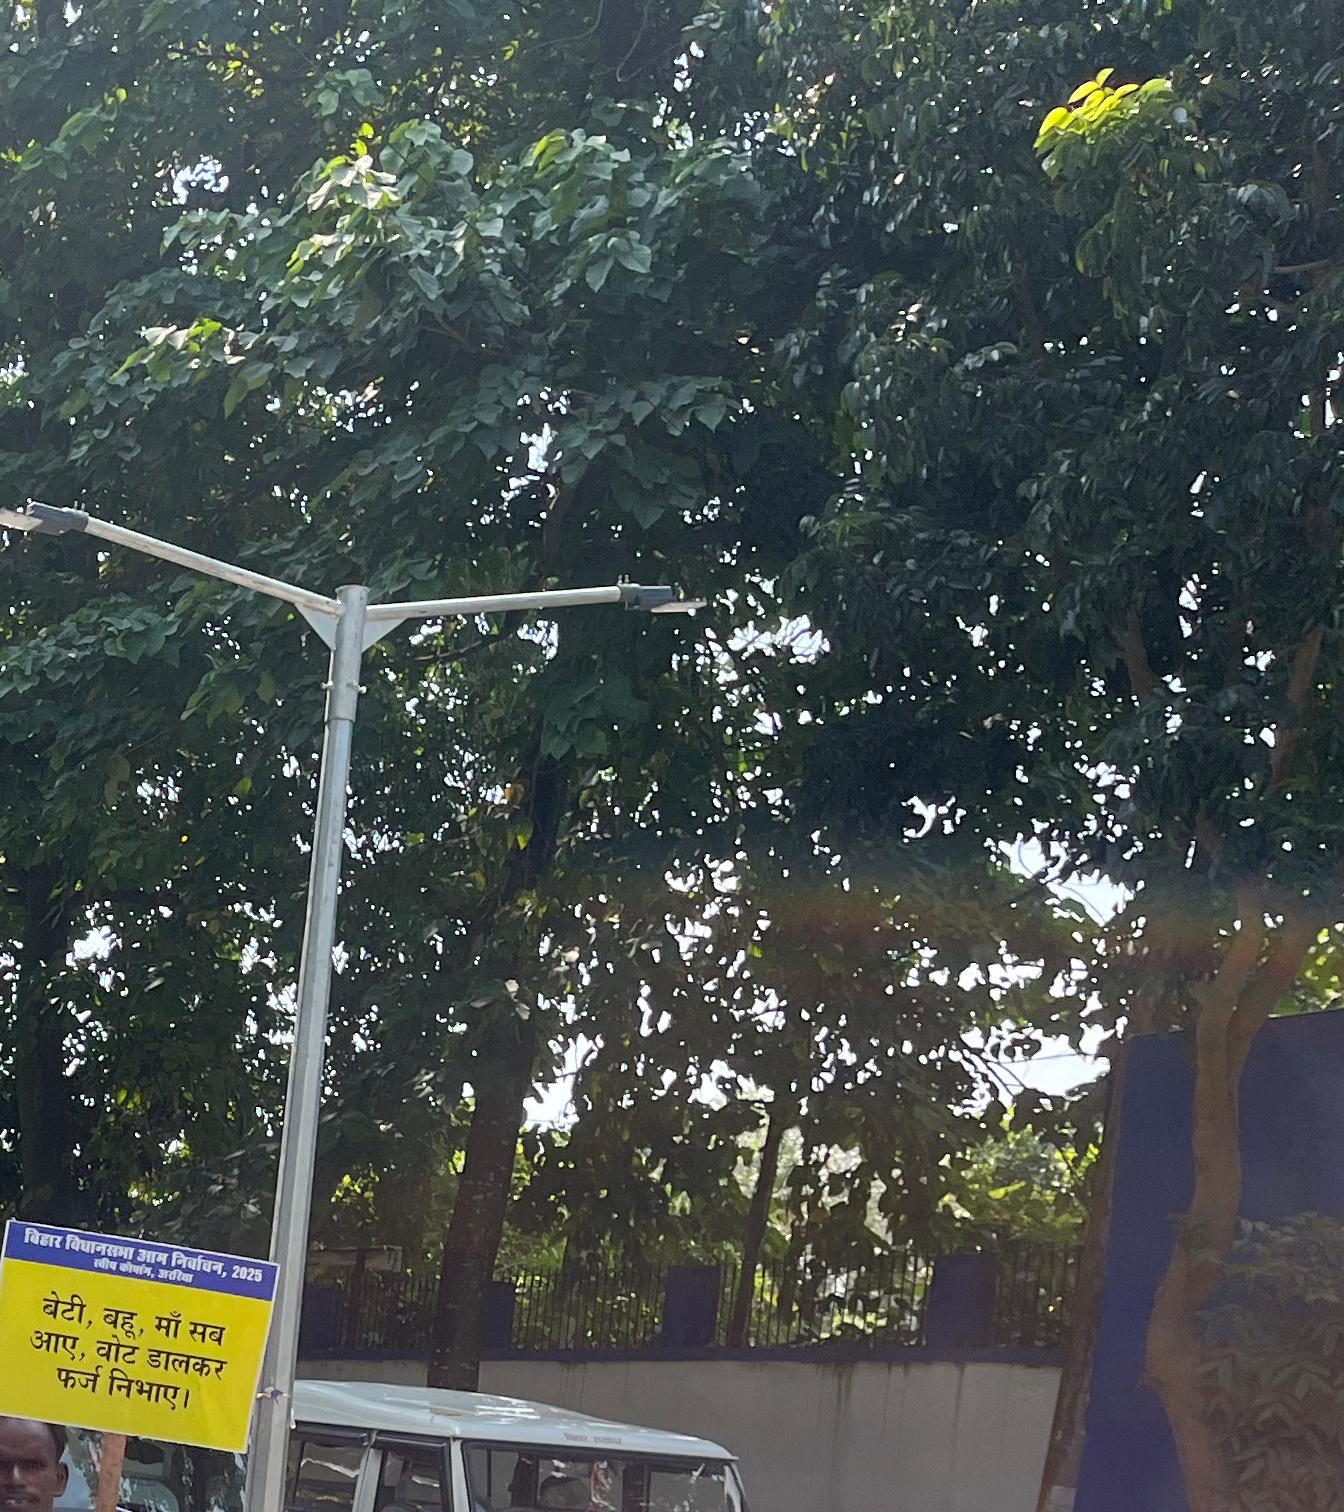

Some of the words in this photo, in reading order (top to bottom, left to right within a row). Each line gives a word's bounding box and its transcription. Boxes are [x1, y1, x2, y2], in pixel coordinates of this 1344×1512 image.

[23, 1227, 61, 1247] बिहार
[65, 1235, 133, 1261] विधानसभा
[136, 1249, 167, 1266] आम
[170, 1252, 227, 1279] निर्वाचन,
[231, 1265, 263, 1283] 2025
[42, 1290, 94, 1330] बेटी,
[103, 1306, 145, 1341] बहू,
[155, 1310, 183, 1339] माँ
[188, 1321, 227, 1347] सब
[29, 1329, 86, 1362] आए,
[95, 1333, 140, 1366] वोट
[146, 1347, 229, 1381] डालकर
[56, 1364, 104, 1394] फर्ज
[108, 1367, 191, 1412] निभाए।
